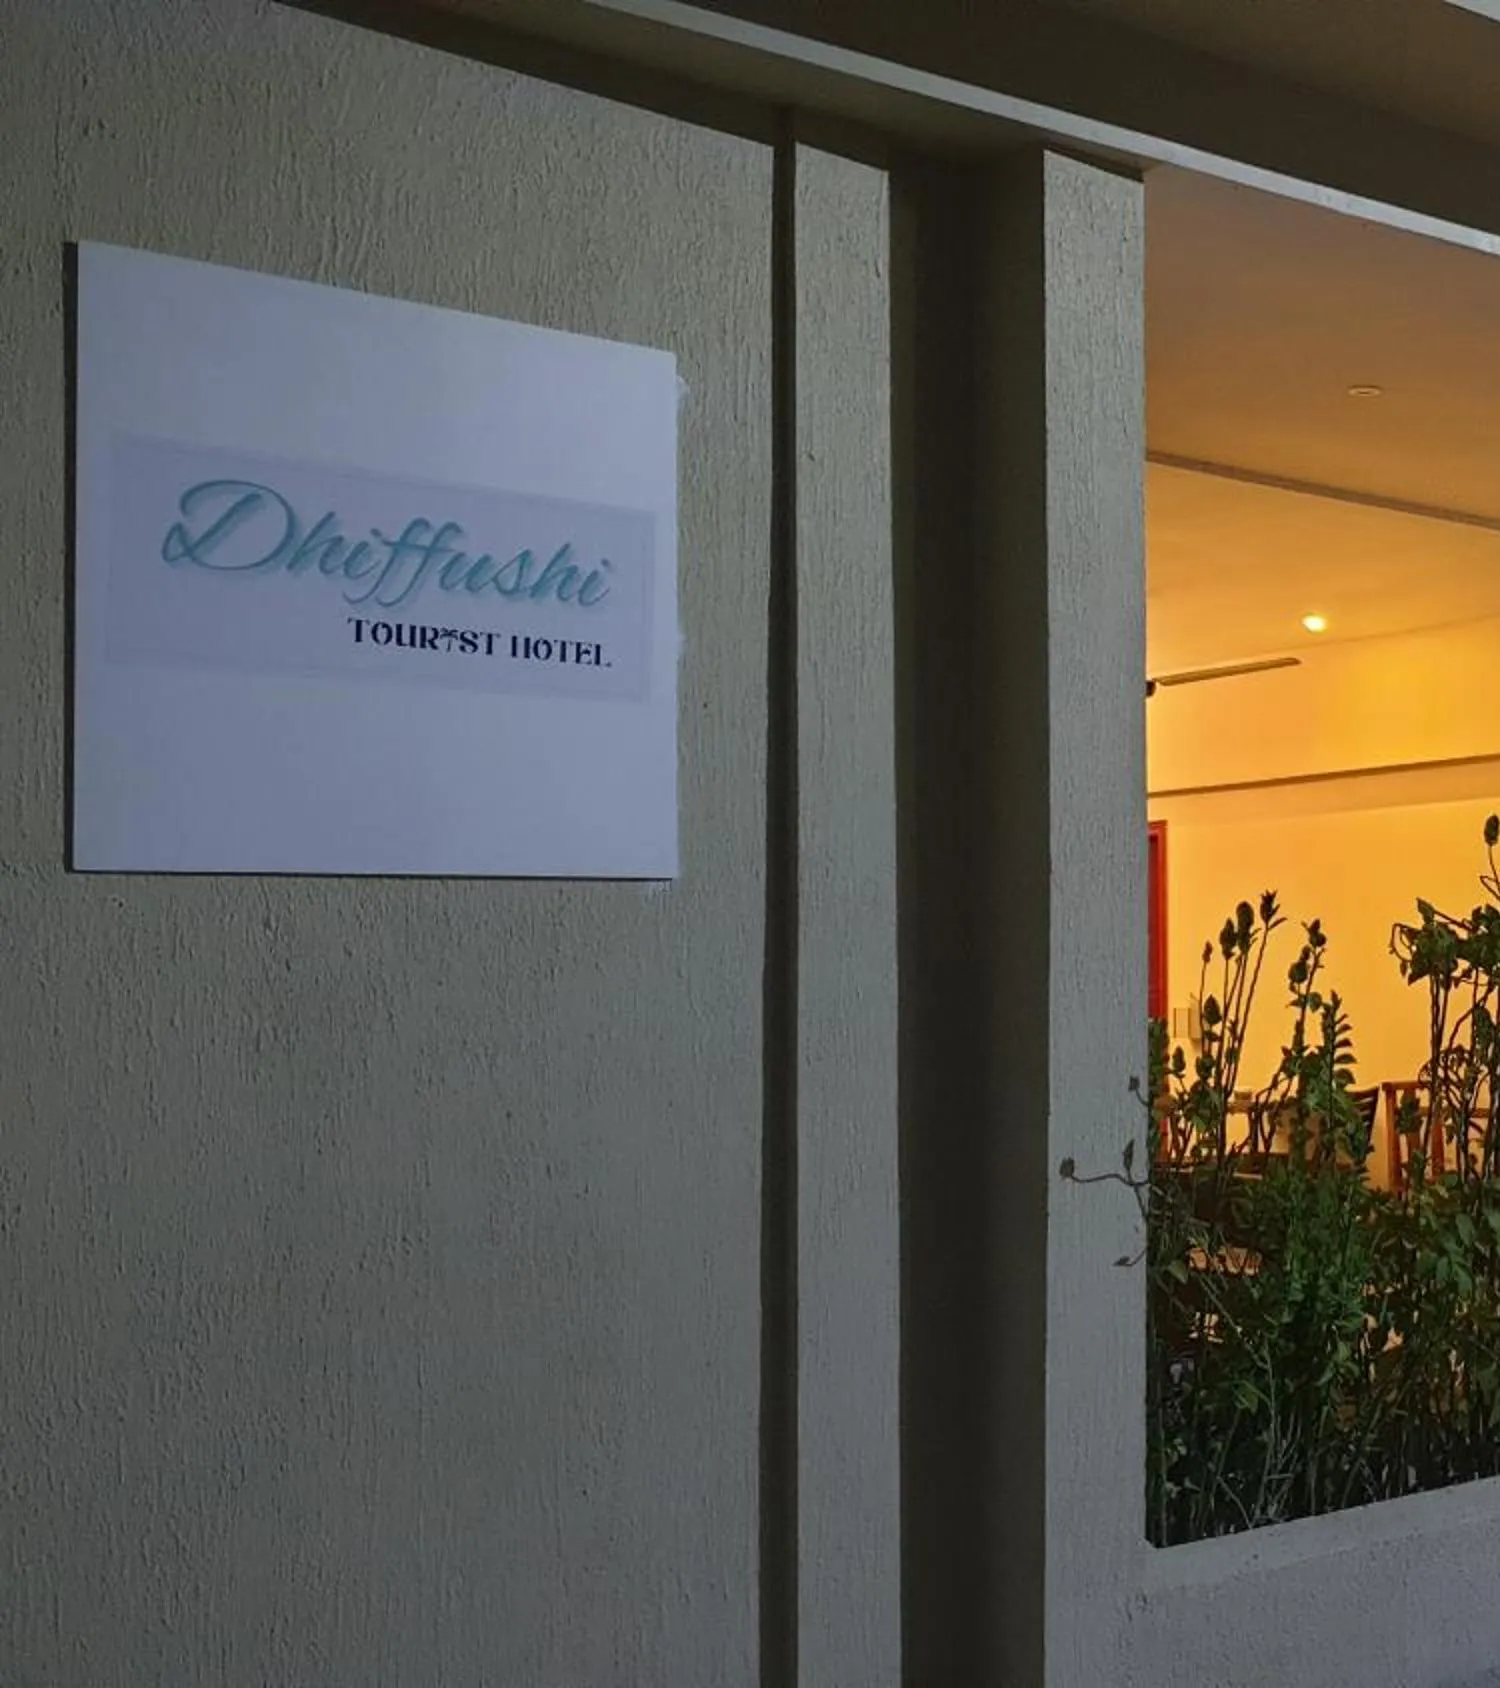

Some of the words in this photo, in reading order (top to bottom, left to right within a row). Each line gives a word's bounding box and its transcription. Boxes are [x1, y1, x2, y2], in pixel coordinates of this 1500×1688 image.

[161, 479, 612, 608] Dhiffushi
[347, 617, 501, 656] TOURIST
[510, 635, 612, 668] HOTEL
